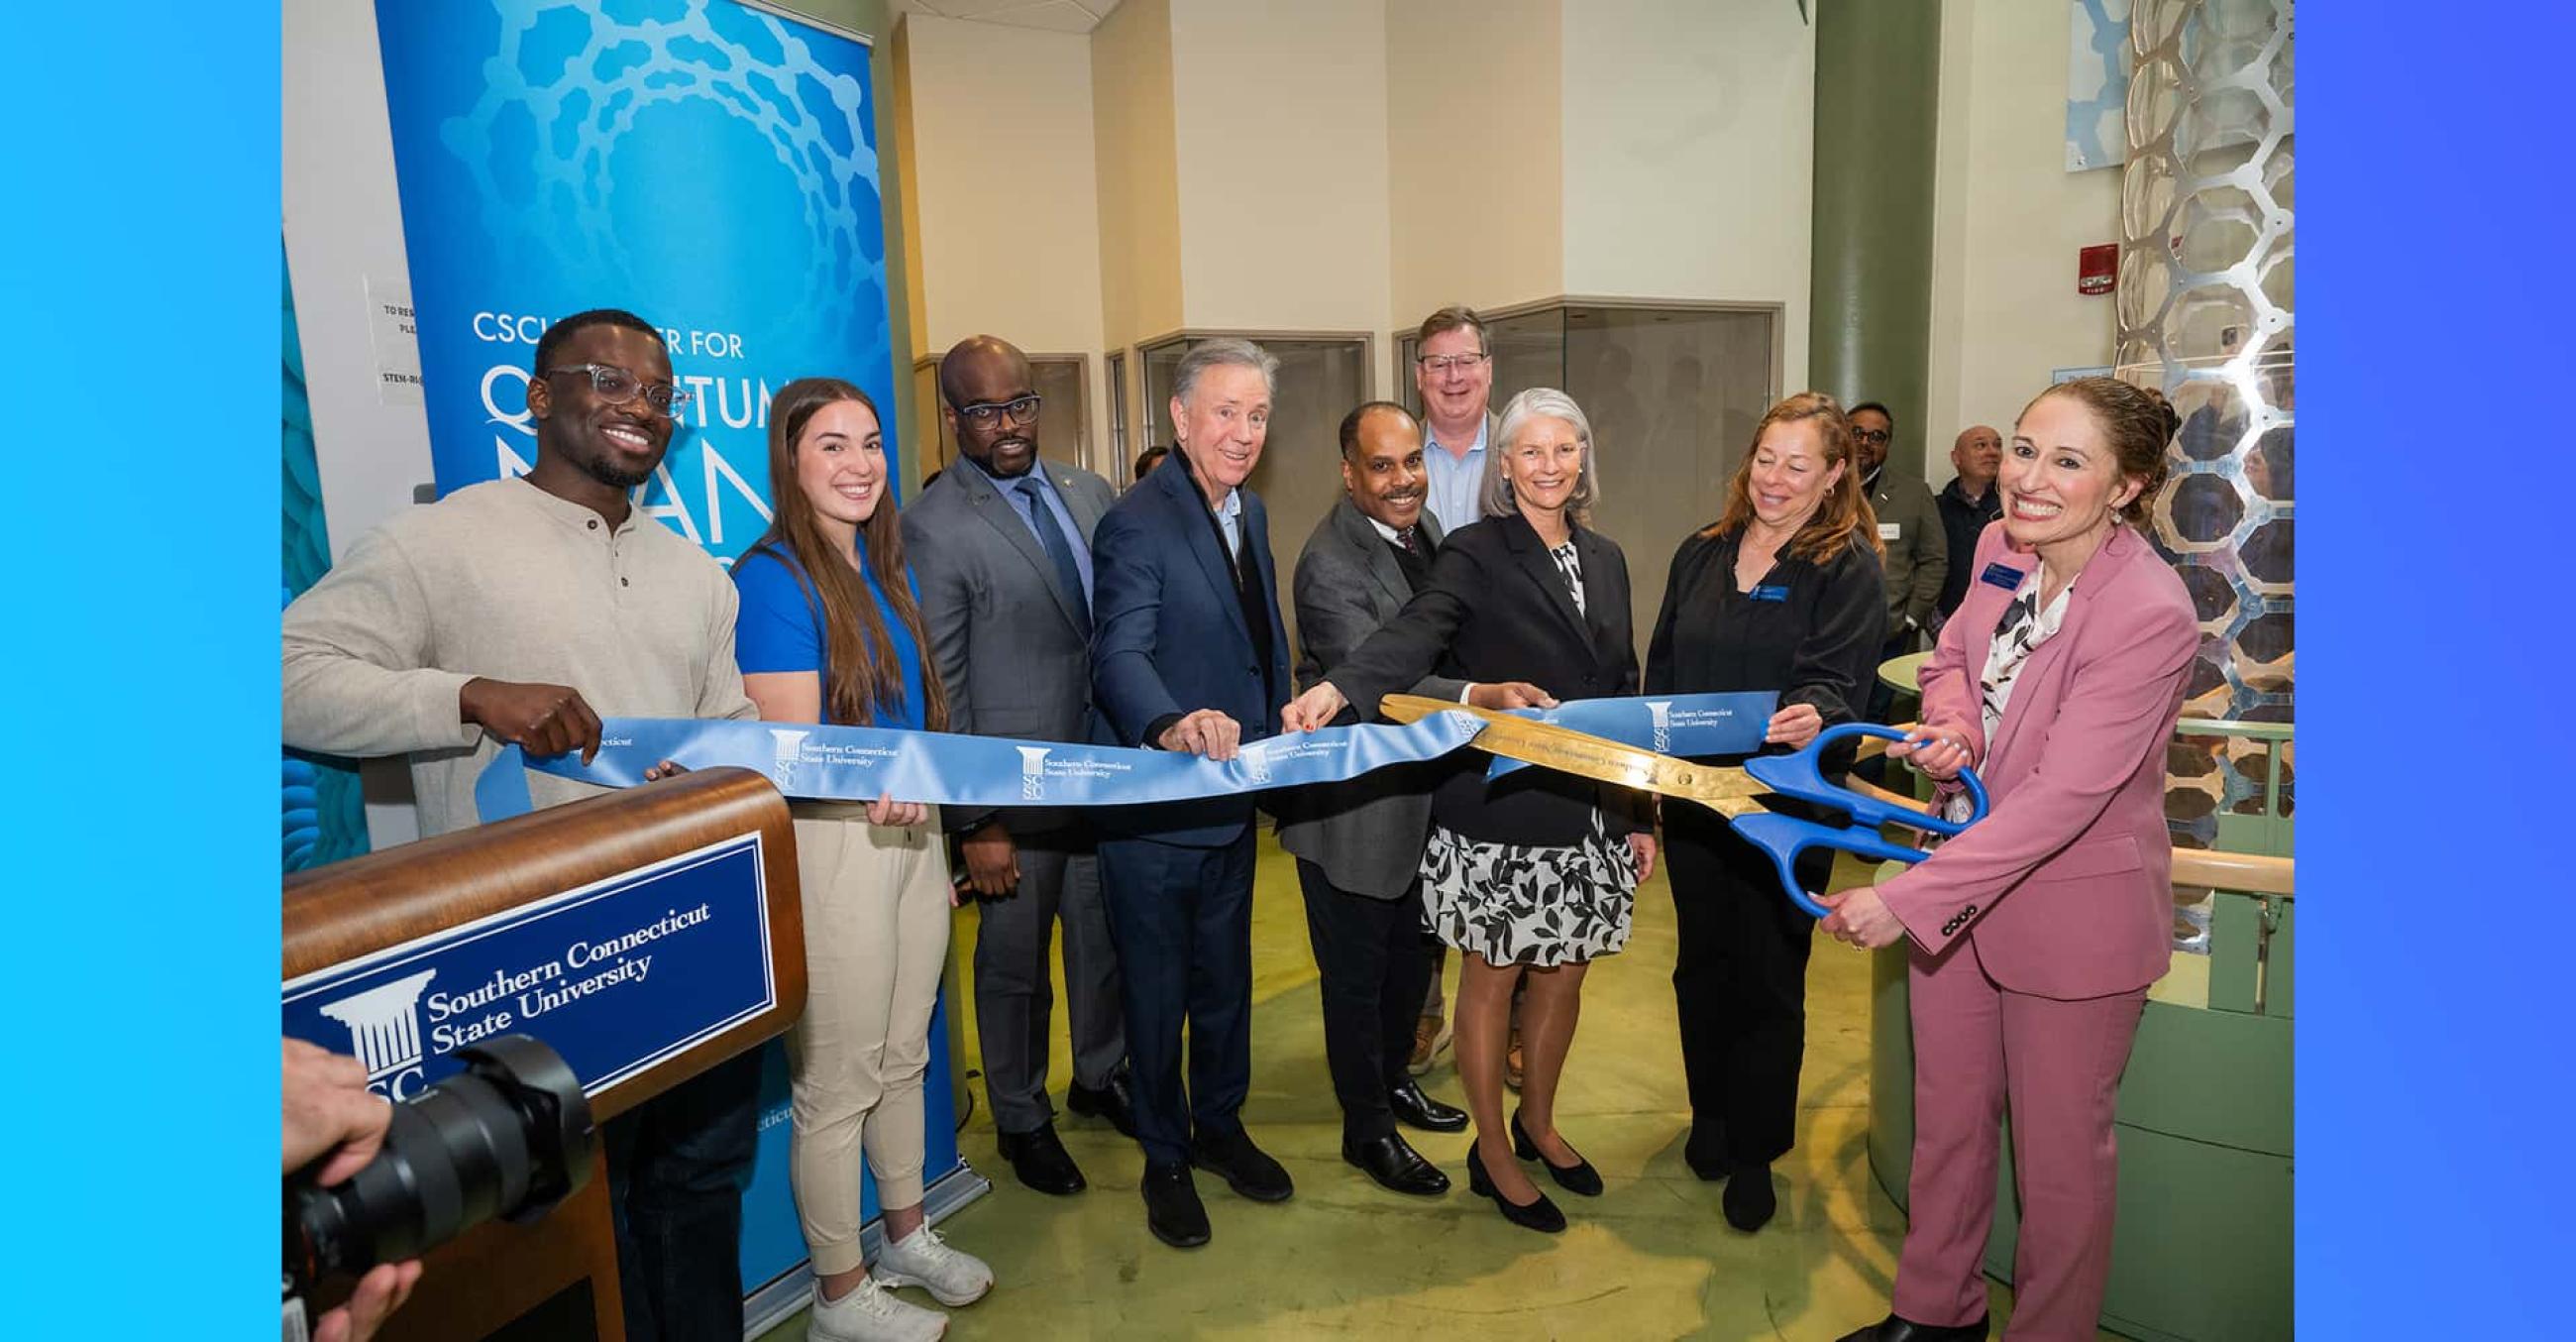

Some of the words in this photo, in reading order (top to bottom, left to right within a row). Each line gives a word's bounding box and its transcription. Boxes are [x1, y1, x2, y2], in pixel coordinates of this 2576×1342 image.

[692, 330, 744, 359] FOR
[826, 754, 873, 767] University
[428, 962, 562, 1023] Southern
[567, 902, 710, 968] Connecticut
[431, 1013, 512, 1055] State
[517, 953, 652, 1020] University
